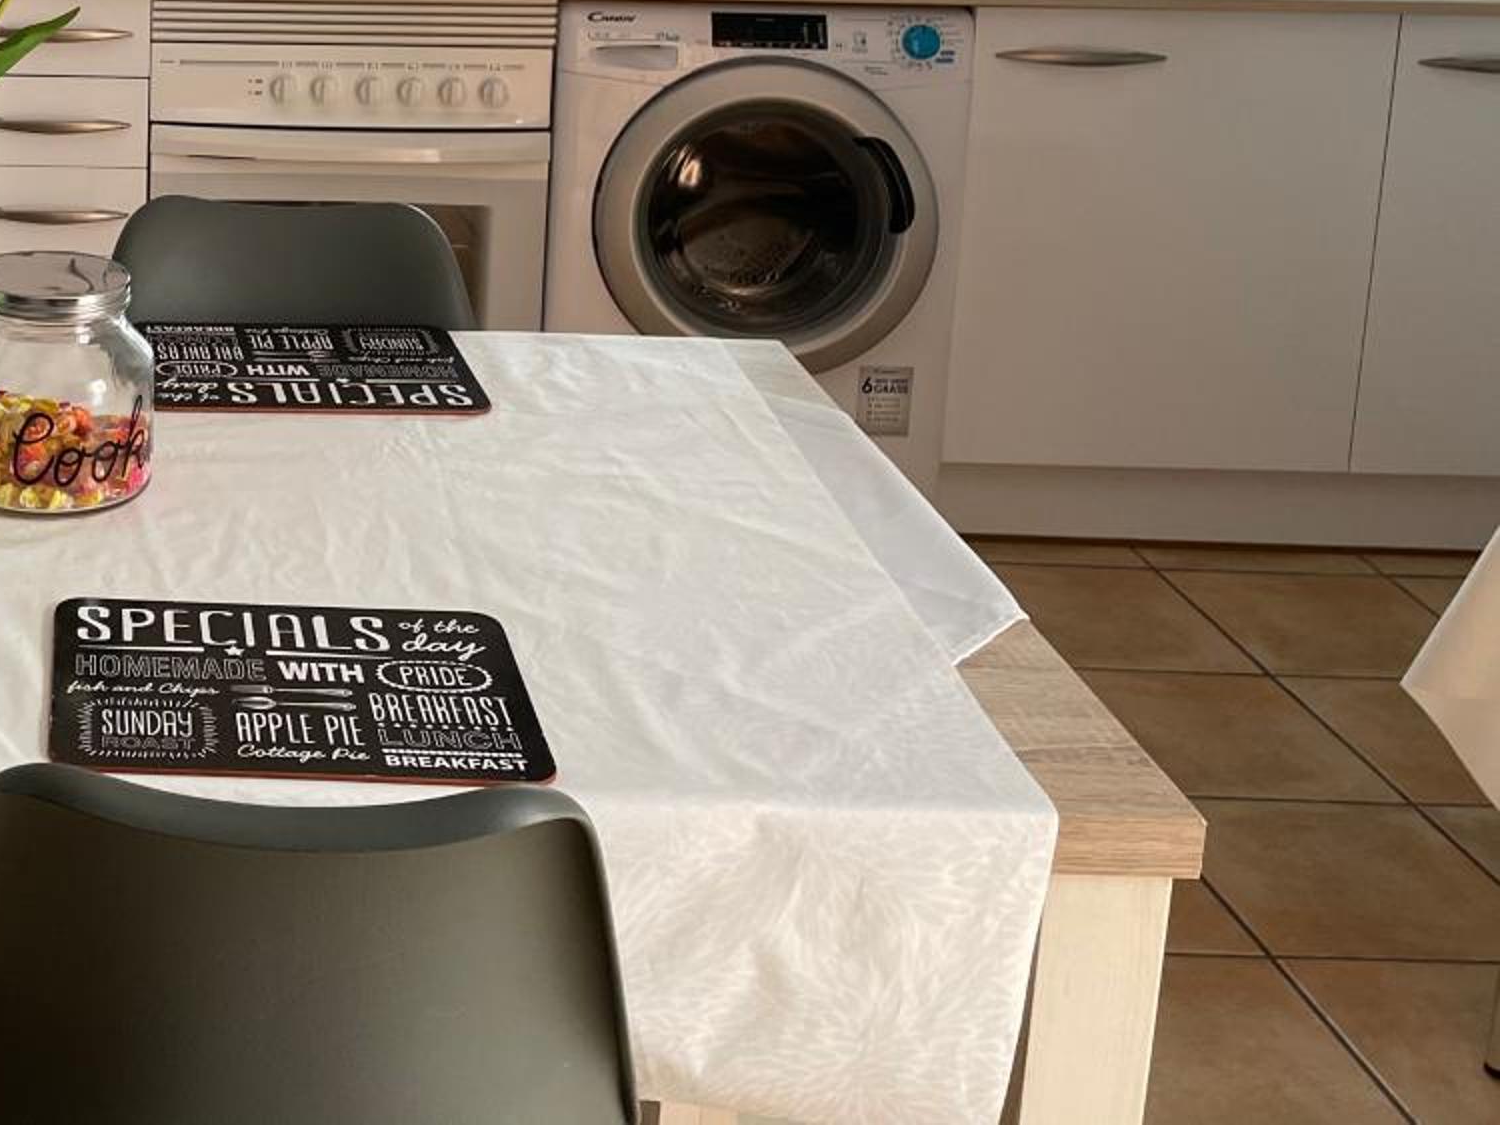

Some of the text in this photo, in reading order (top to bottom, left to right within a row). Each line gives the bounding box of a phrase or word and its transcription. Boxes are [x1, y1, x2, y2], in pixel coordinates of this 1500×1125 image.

[250, 334, 275, 349] PIE
[279, 334, 334, 350] APPLE
[157, 343, 245, 361] BREAKFAS
[174, 364, 222, 375] PRIDE
[246, 364, 310, 376] WITH
[226, 382, 474, 406] SPECIALS
[77, 605, 480, 652] SPECIALS of the
[402, 632, 487, 661] day
[74, 654, 473, 687] HOMEMADE WITH PRIDE
[67, 679, 220, 698] fish and Chips
[368, 692, 513, 727] BREAKFAST
[101, 709, 193, 737] SUNDAY
[235, 711, 367, 746] APPLE PIE
[101, 736, 197, 750] ROAST
[376, 727, 523, 751] LUNCH
[236, 744, 370, 763] Cottage Pie
[384, 755, 529, 771] BREAKFAST
